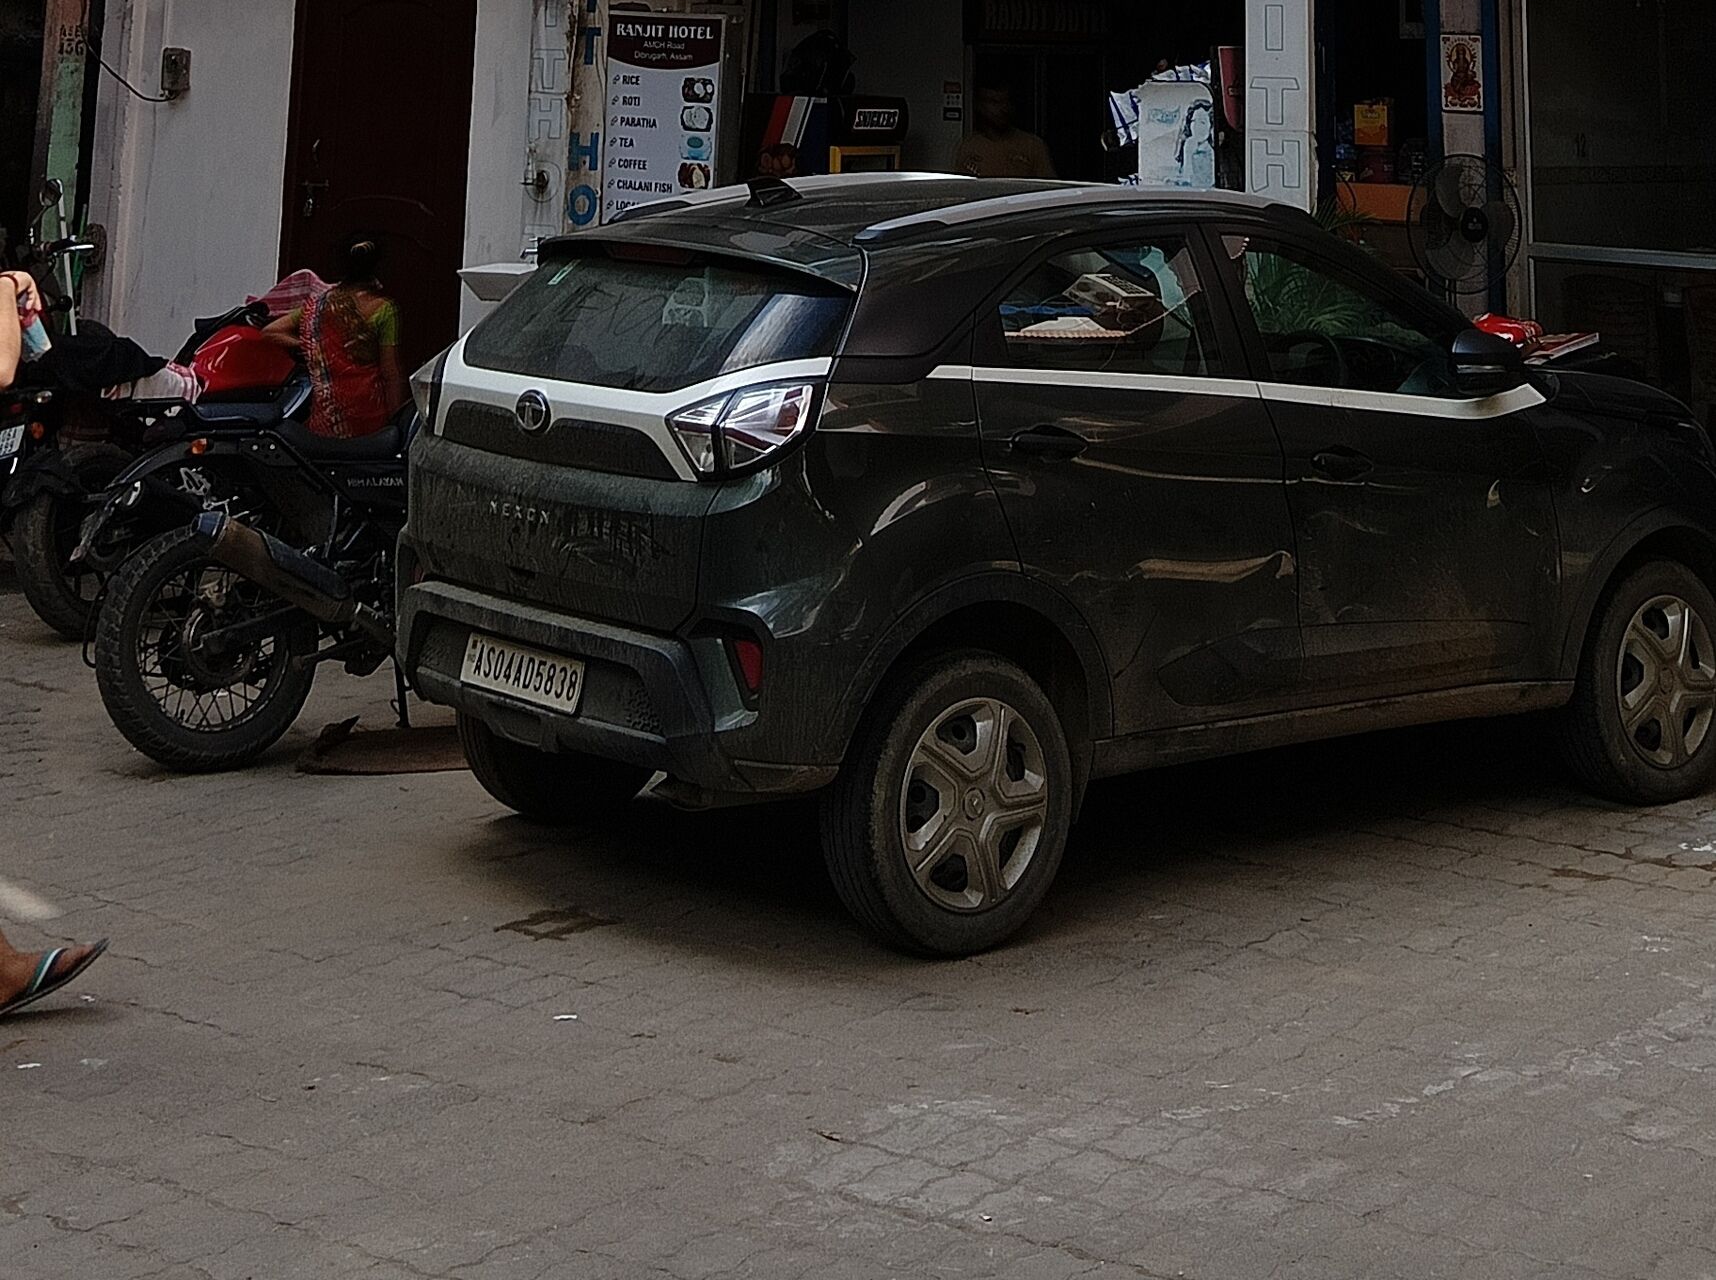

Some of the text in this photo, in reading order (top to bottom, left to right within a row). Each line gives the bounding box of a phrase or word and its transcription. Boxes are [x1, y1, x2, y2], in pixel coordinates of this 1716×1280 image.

[616, 23, 714, 40] RANJIT HOTEL
[622, 75, 640, 85] RICE
[622, 96, 640, 106] ROTI
[620, 116, 657, 128] PARATHA
[619, 137, 634, 148] TEA
[618, 158, 647, 170] COFFEE
[654, 182, 673, 193] FISH
[473, 642, 578, 702] AS04AD5838
